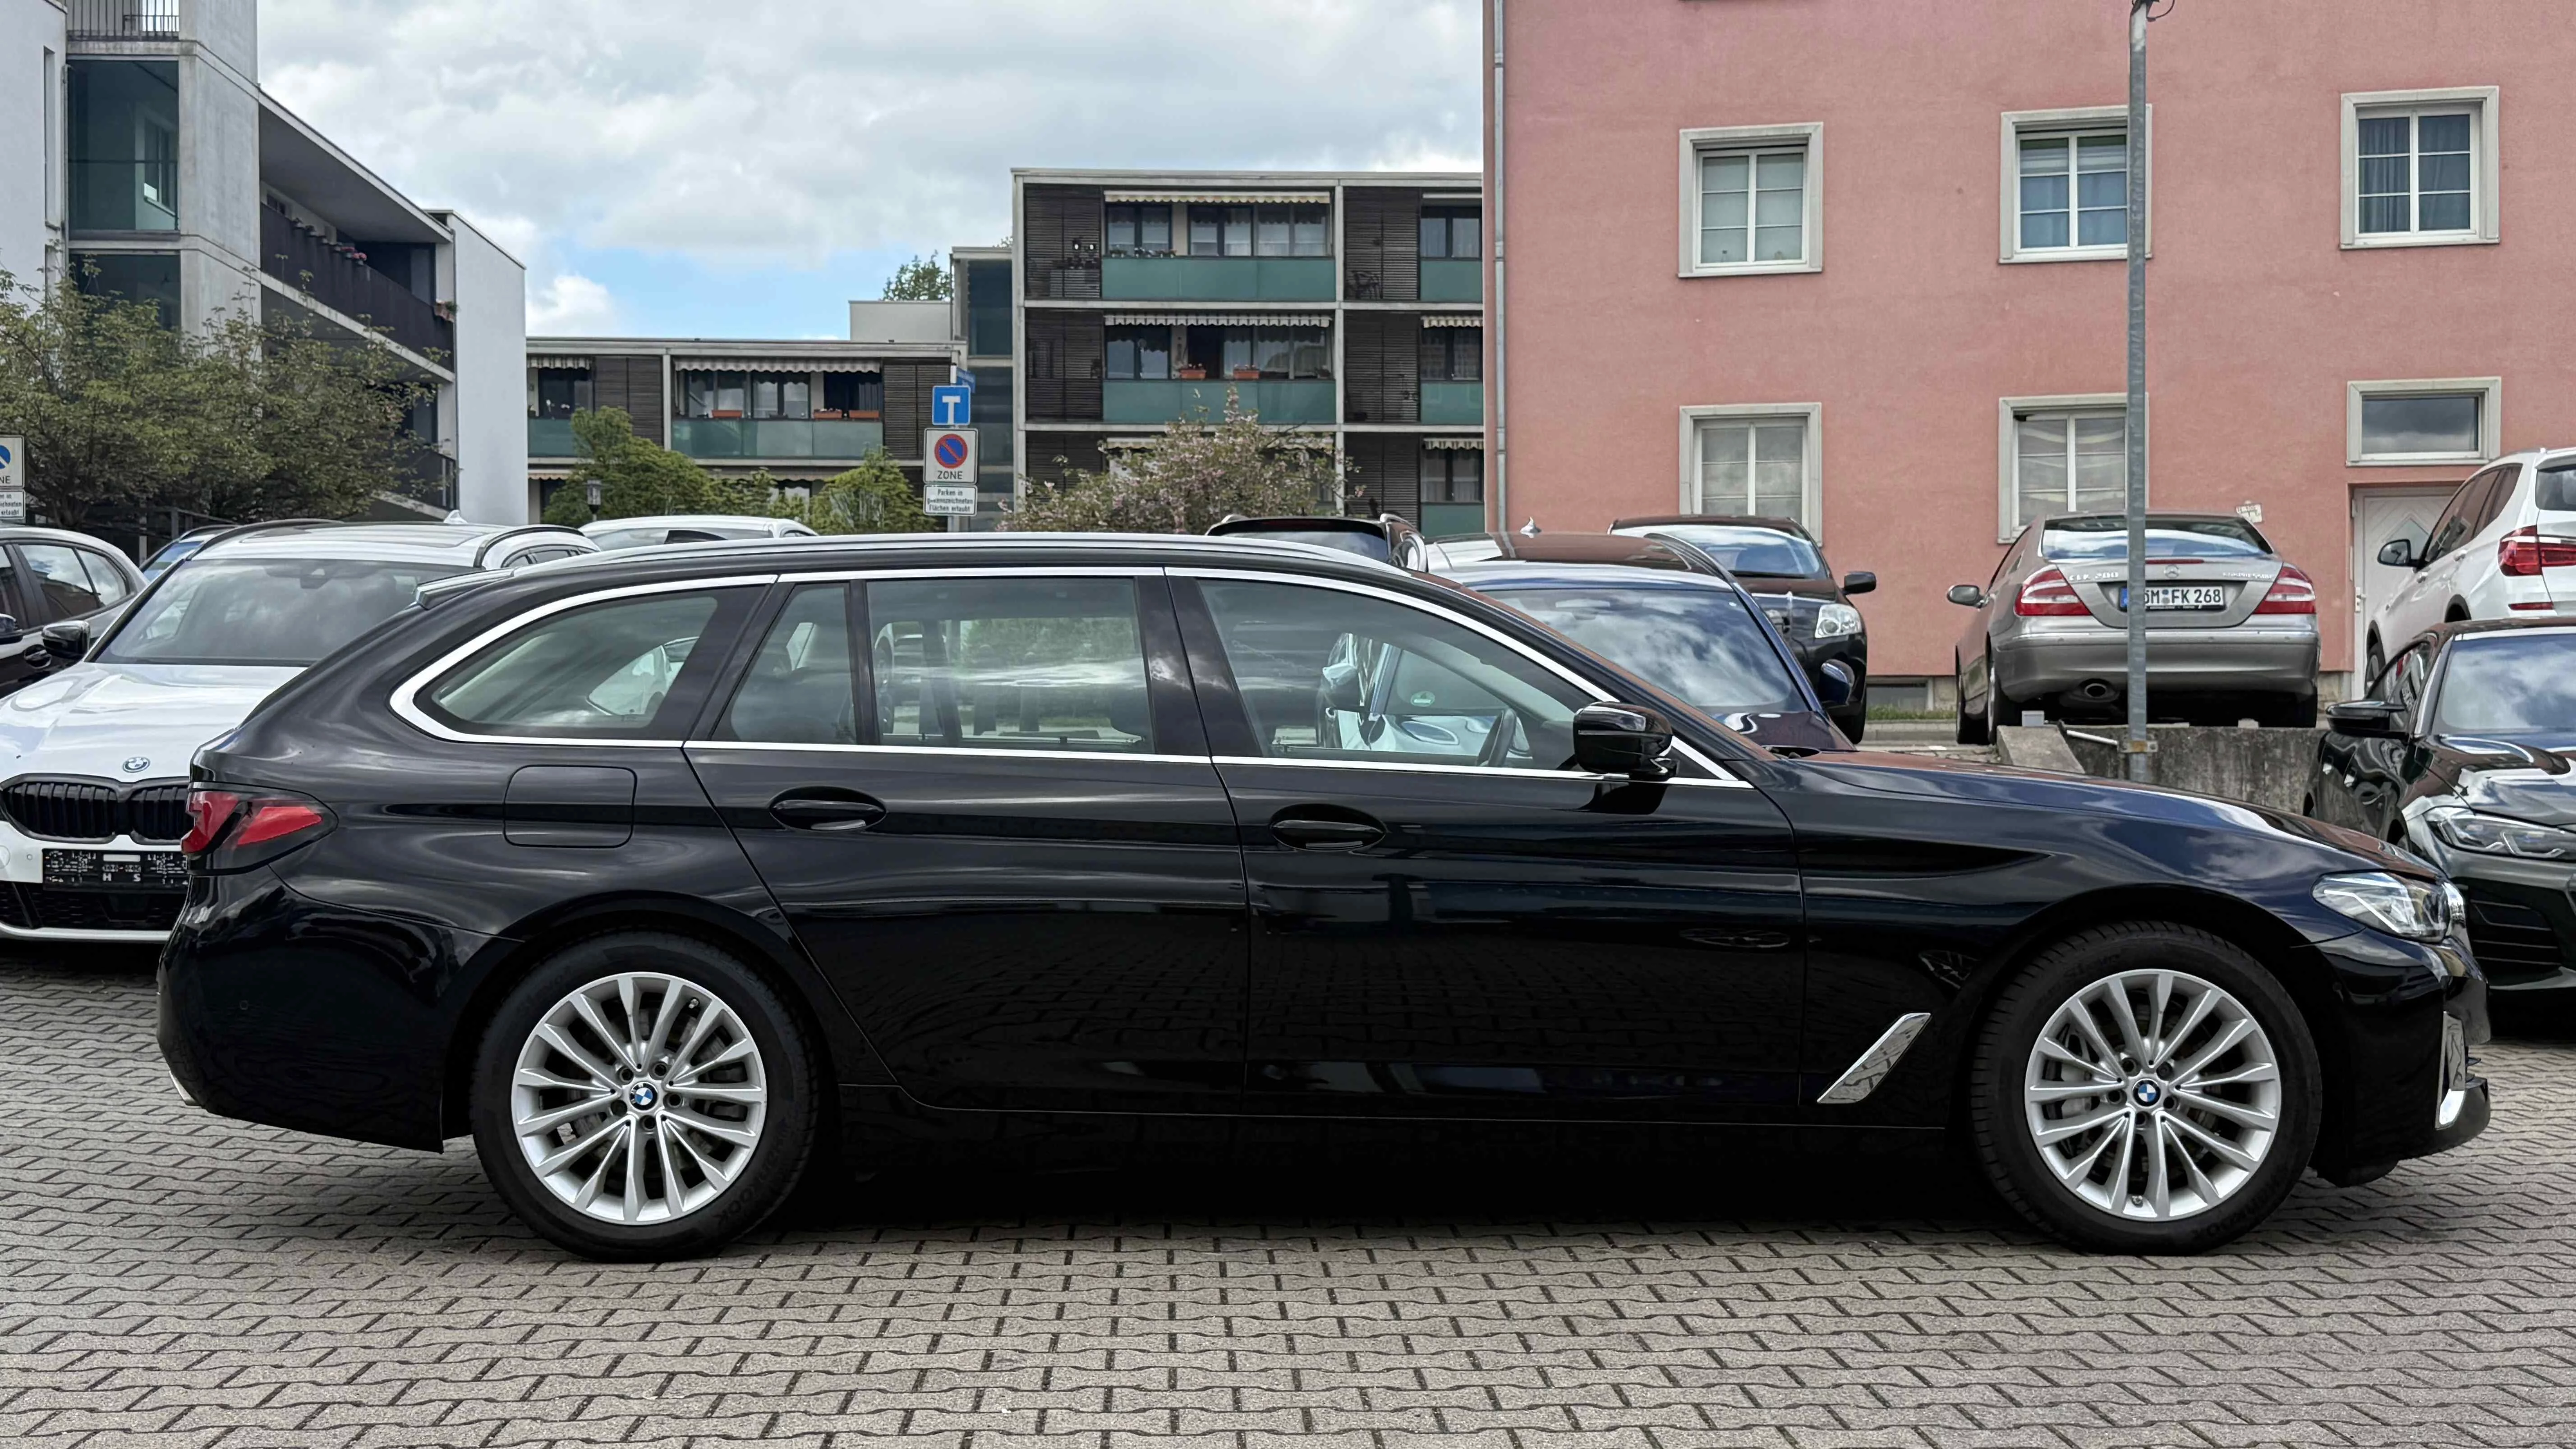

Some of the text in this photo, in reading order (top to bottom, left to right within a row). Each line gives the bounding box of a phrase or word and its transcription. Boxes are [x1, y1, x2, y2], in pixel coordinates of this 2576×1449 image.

[0, 476, 11, 484] NE
[937, 470, 963, 480] ZONE
[2171, 589, 2190, 603] FK
[2194, 589, 2221, 603] 268
